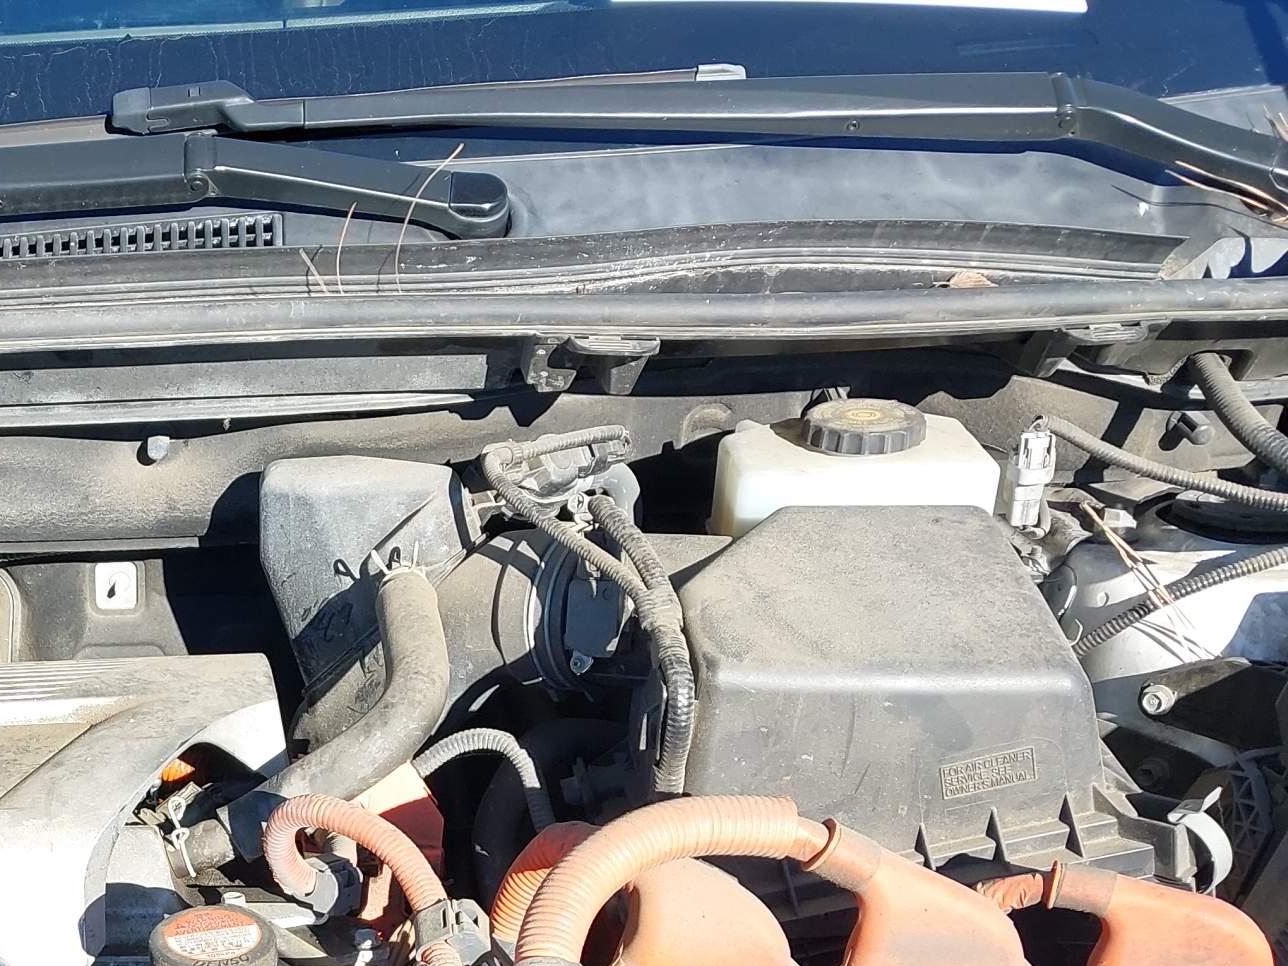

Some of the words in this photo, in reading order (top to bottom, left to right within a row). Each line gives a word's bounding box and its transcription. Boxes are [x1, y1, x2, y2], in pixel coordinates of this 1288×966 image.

[943, 766, 963, 778] FOR
[965, 761, 983, 773] AIR
[983, 751, 1031, 769] CLEANER
[991, 765, 1012, 778] SEE
